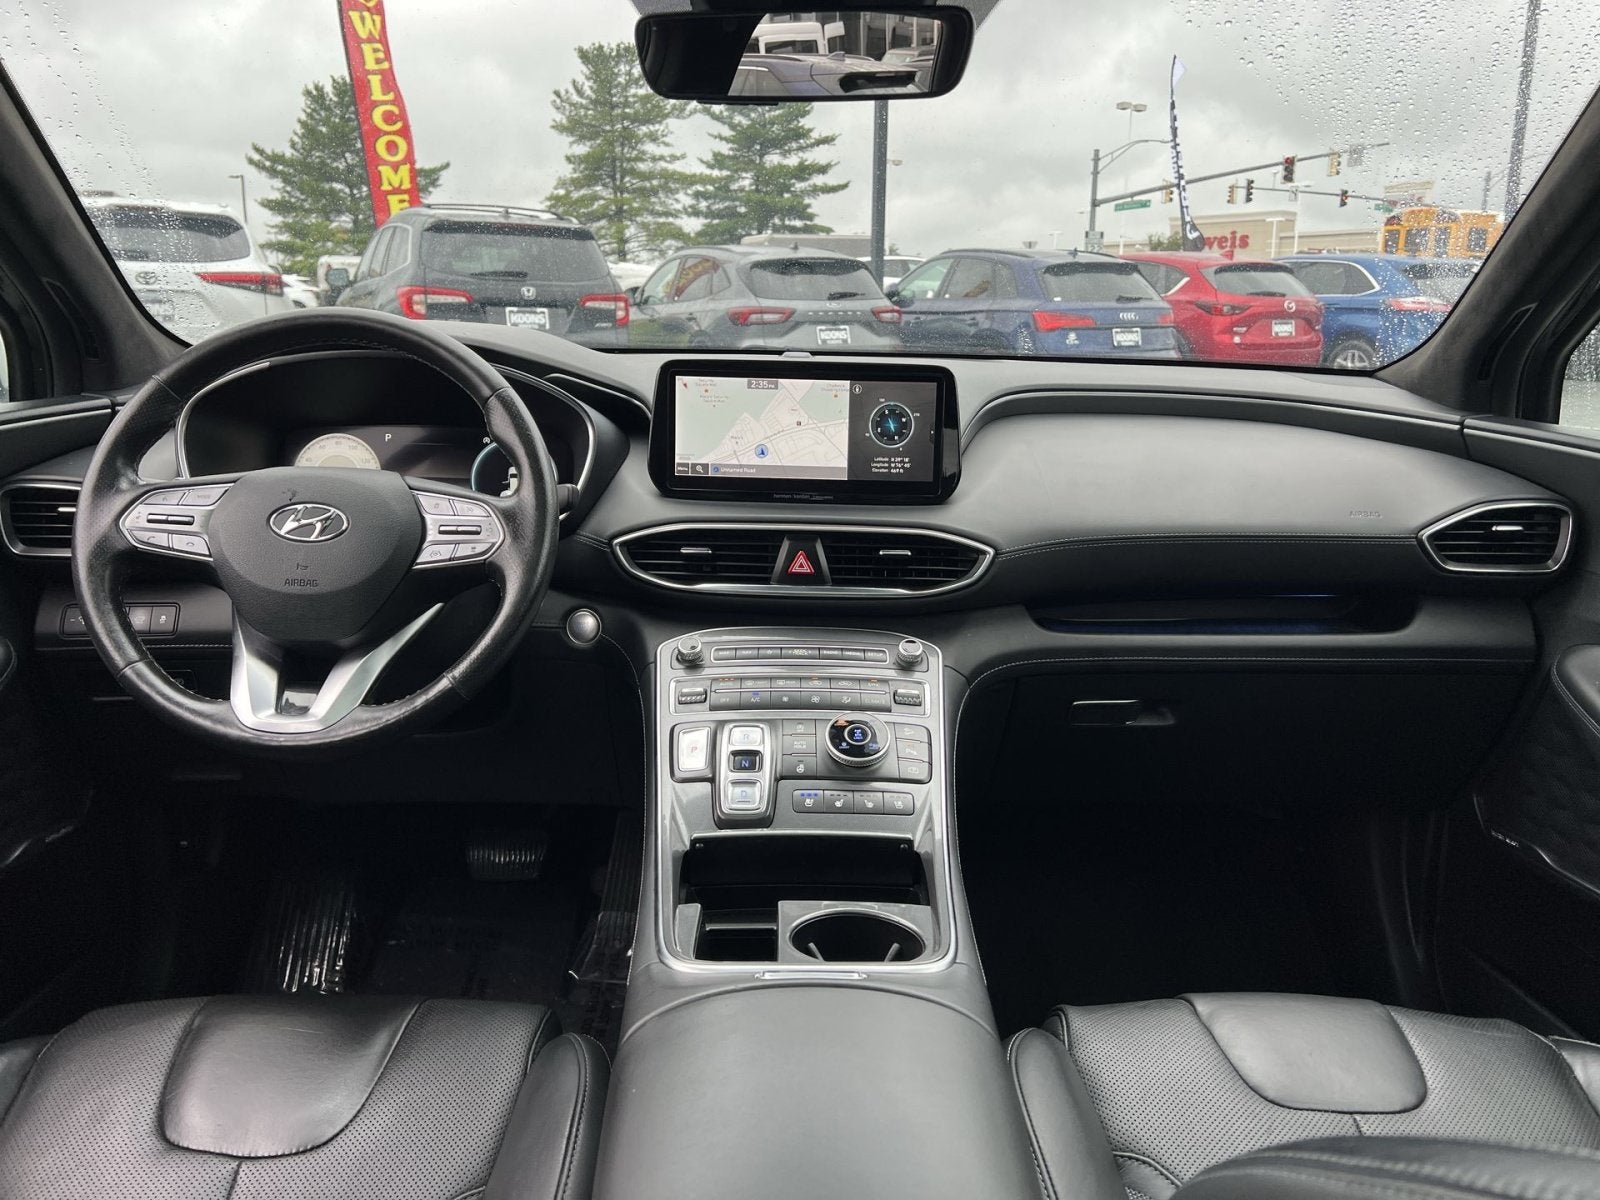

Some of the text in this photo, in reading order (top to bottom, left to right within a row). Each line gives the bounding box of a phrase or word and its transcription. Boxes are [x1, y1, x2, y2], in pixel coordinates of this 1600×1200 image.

[511, 312, 546, 325] KOONS
[751, 380, 769, 389] 2:35
[385, 433, 392, 442] P
[284, 578, 319, 588] AIRBAG
[741, 760, 749, 768] N
[740, 790, 748, 798] D
